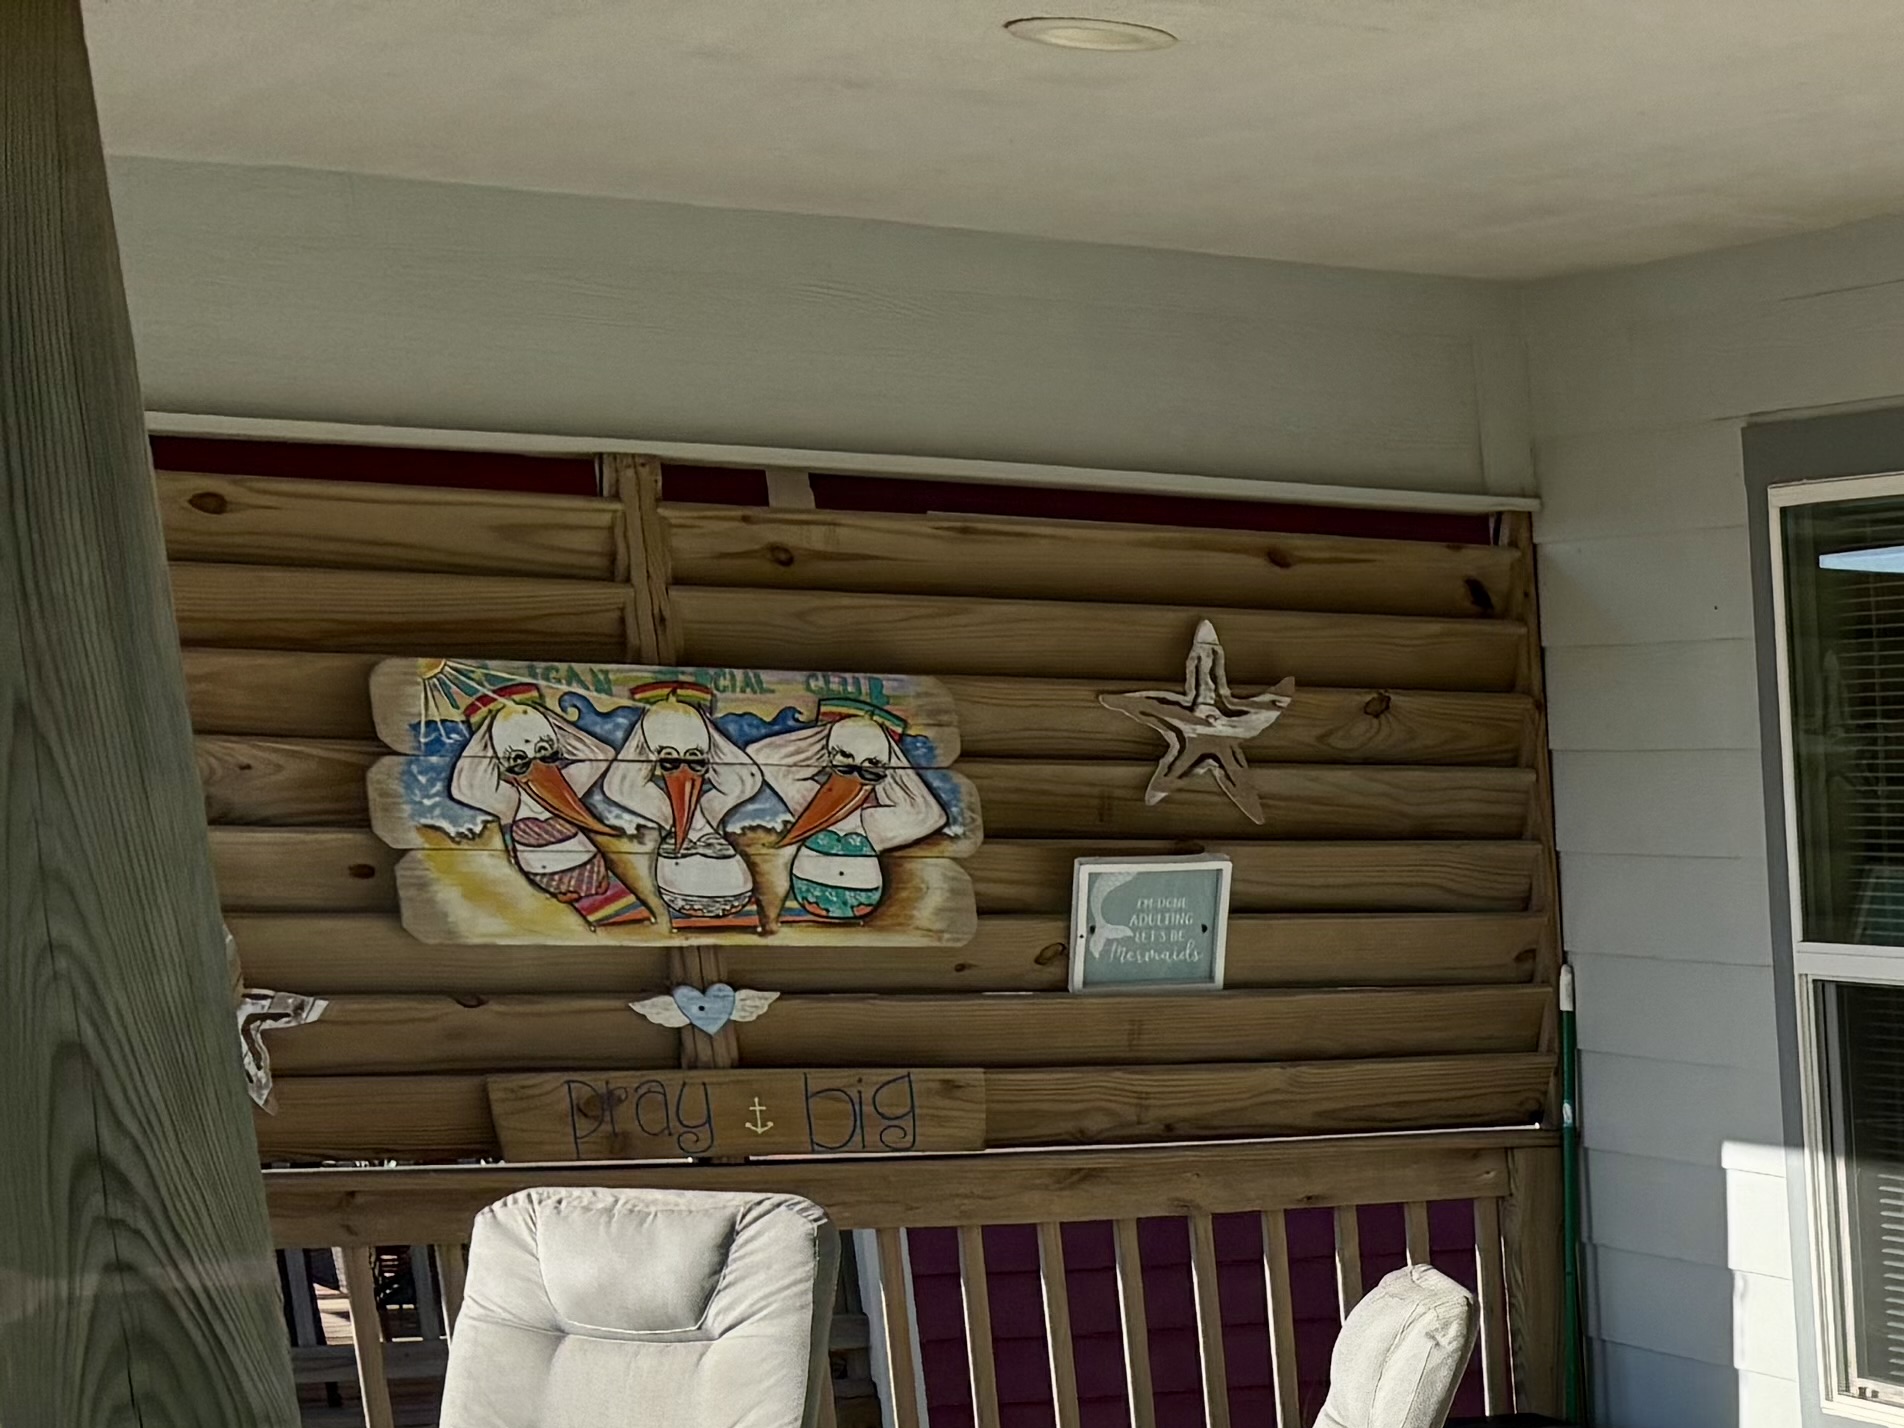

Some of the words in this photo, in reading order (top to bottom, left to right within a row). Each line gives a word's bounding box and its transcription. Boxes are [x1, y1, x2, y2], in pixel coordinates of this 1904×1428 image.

[1129, 912, 1194, 927] ADULTING
[1170, 929, 1186, 942] BE
[1109, 938, 1202, 964] Mermaids
[563, 1078, 715, 1160] pray
[802, 1071, 917, 1152] big
